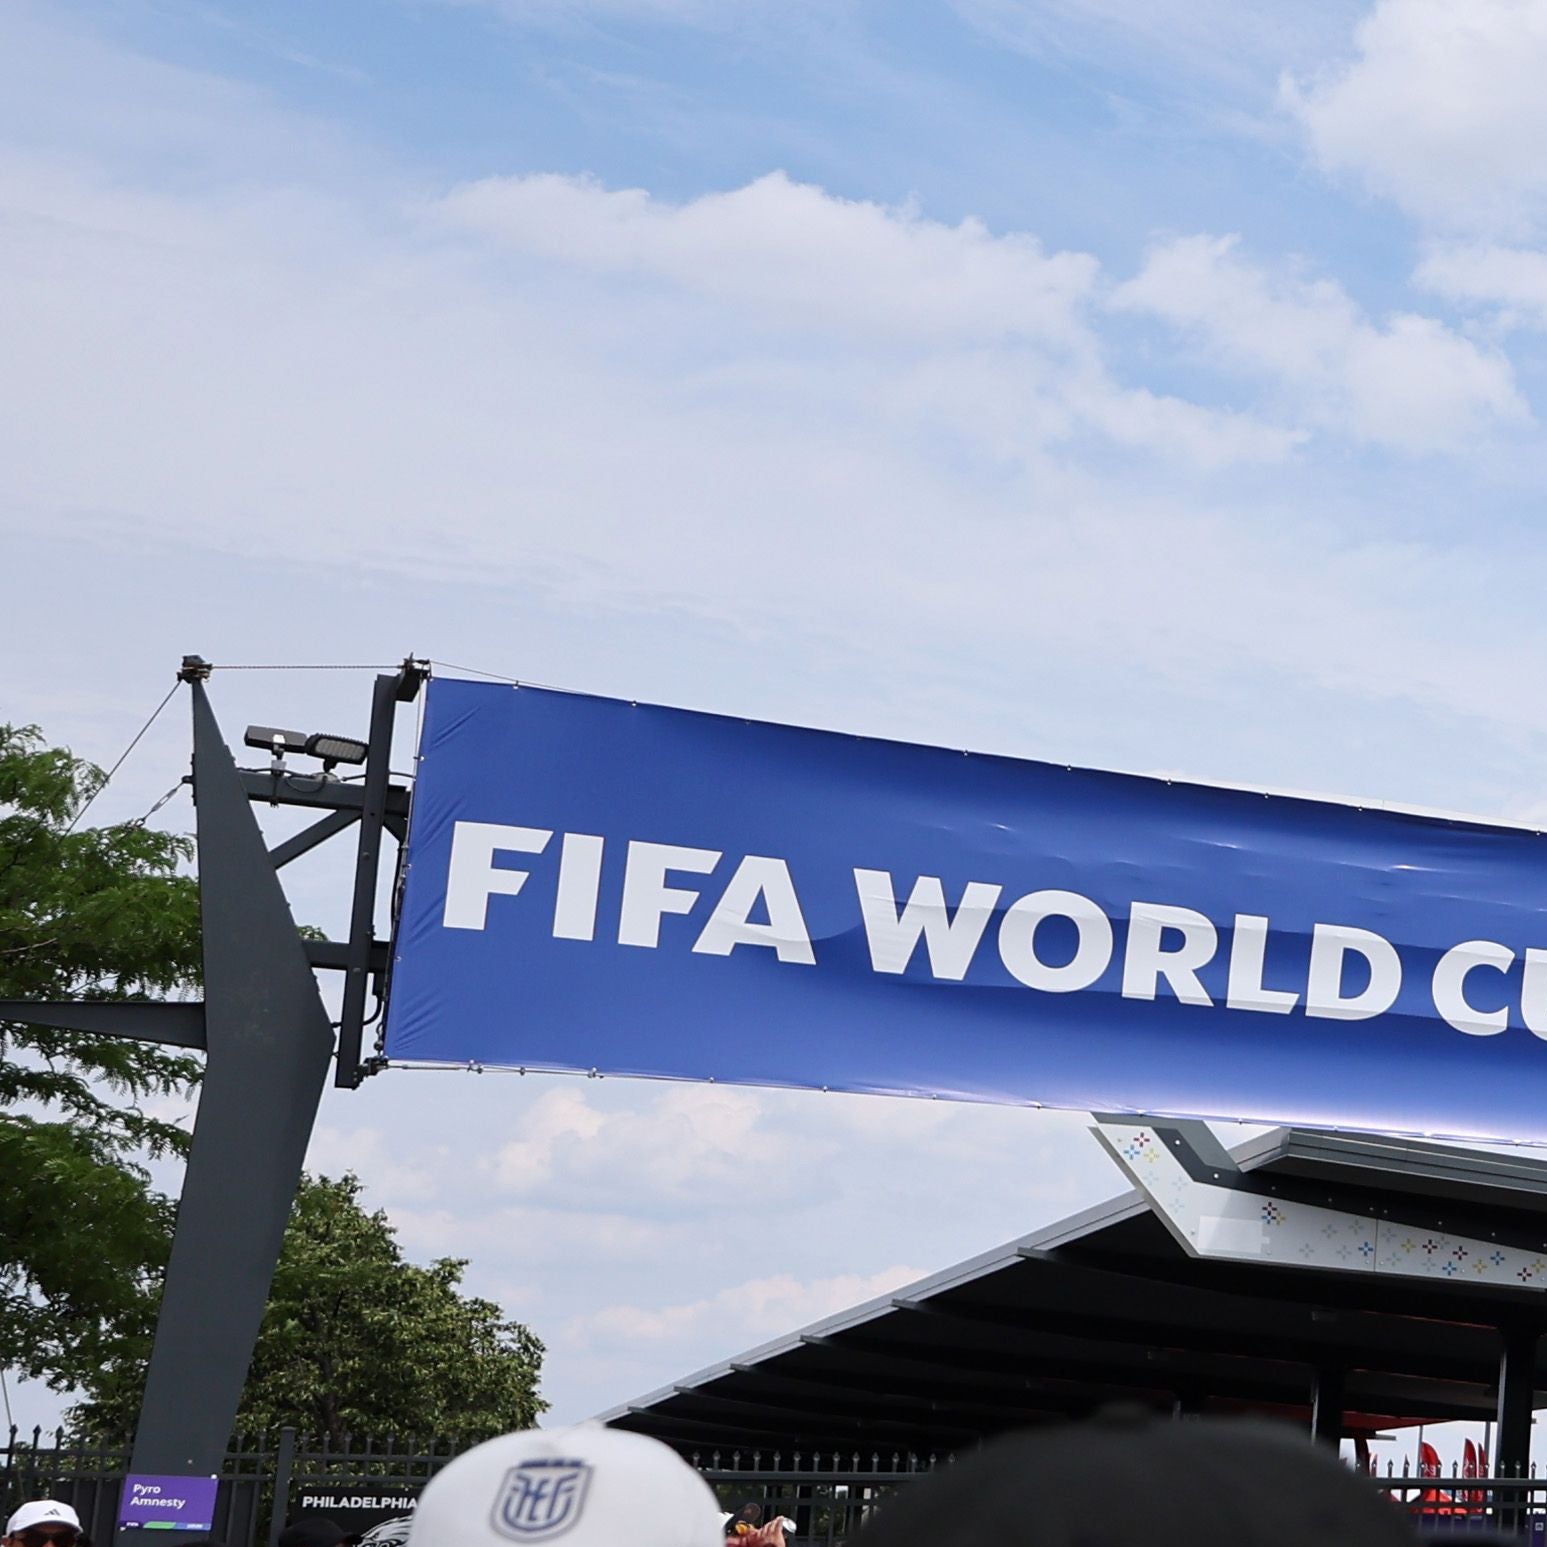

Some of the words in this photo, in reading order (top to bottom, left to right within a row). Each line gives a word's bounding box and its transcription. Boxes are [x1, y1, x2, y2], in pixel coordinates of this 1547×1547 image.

[442, 820, 817, 967] FIFA
[852, 868, 1403, 1021] WORLD
[132, 1484, 161, 1495] Pyro
[130, 1496, 186, 1509] Amnesty
[302, 1496, 418, 1508] PHILADELPHIA
